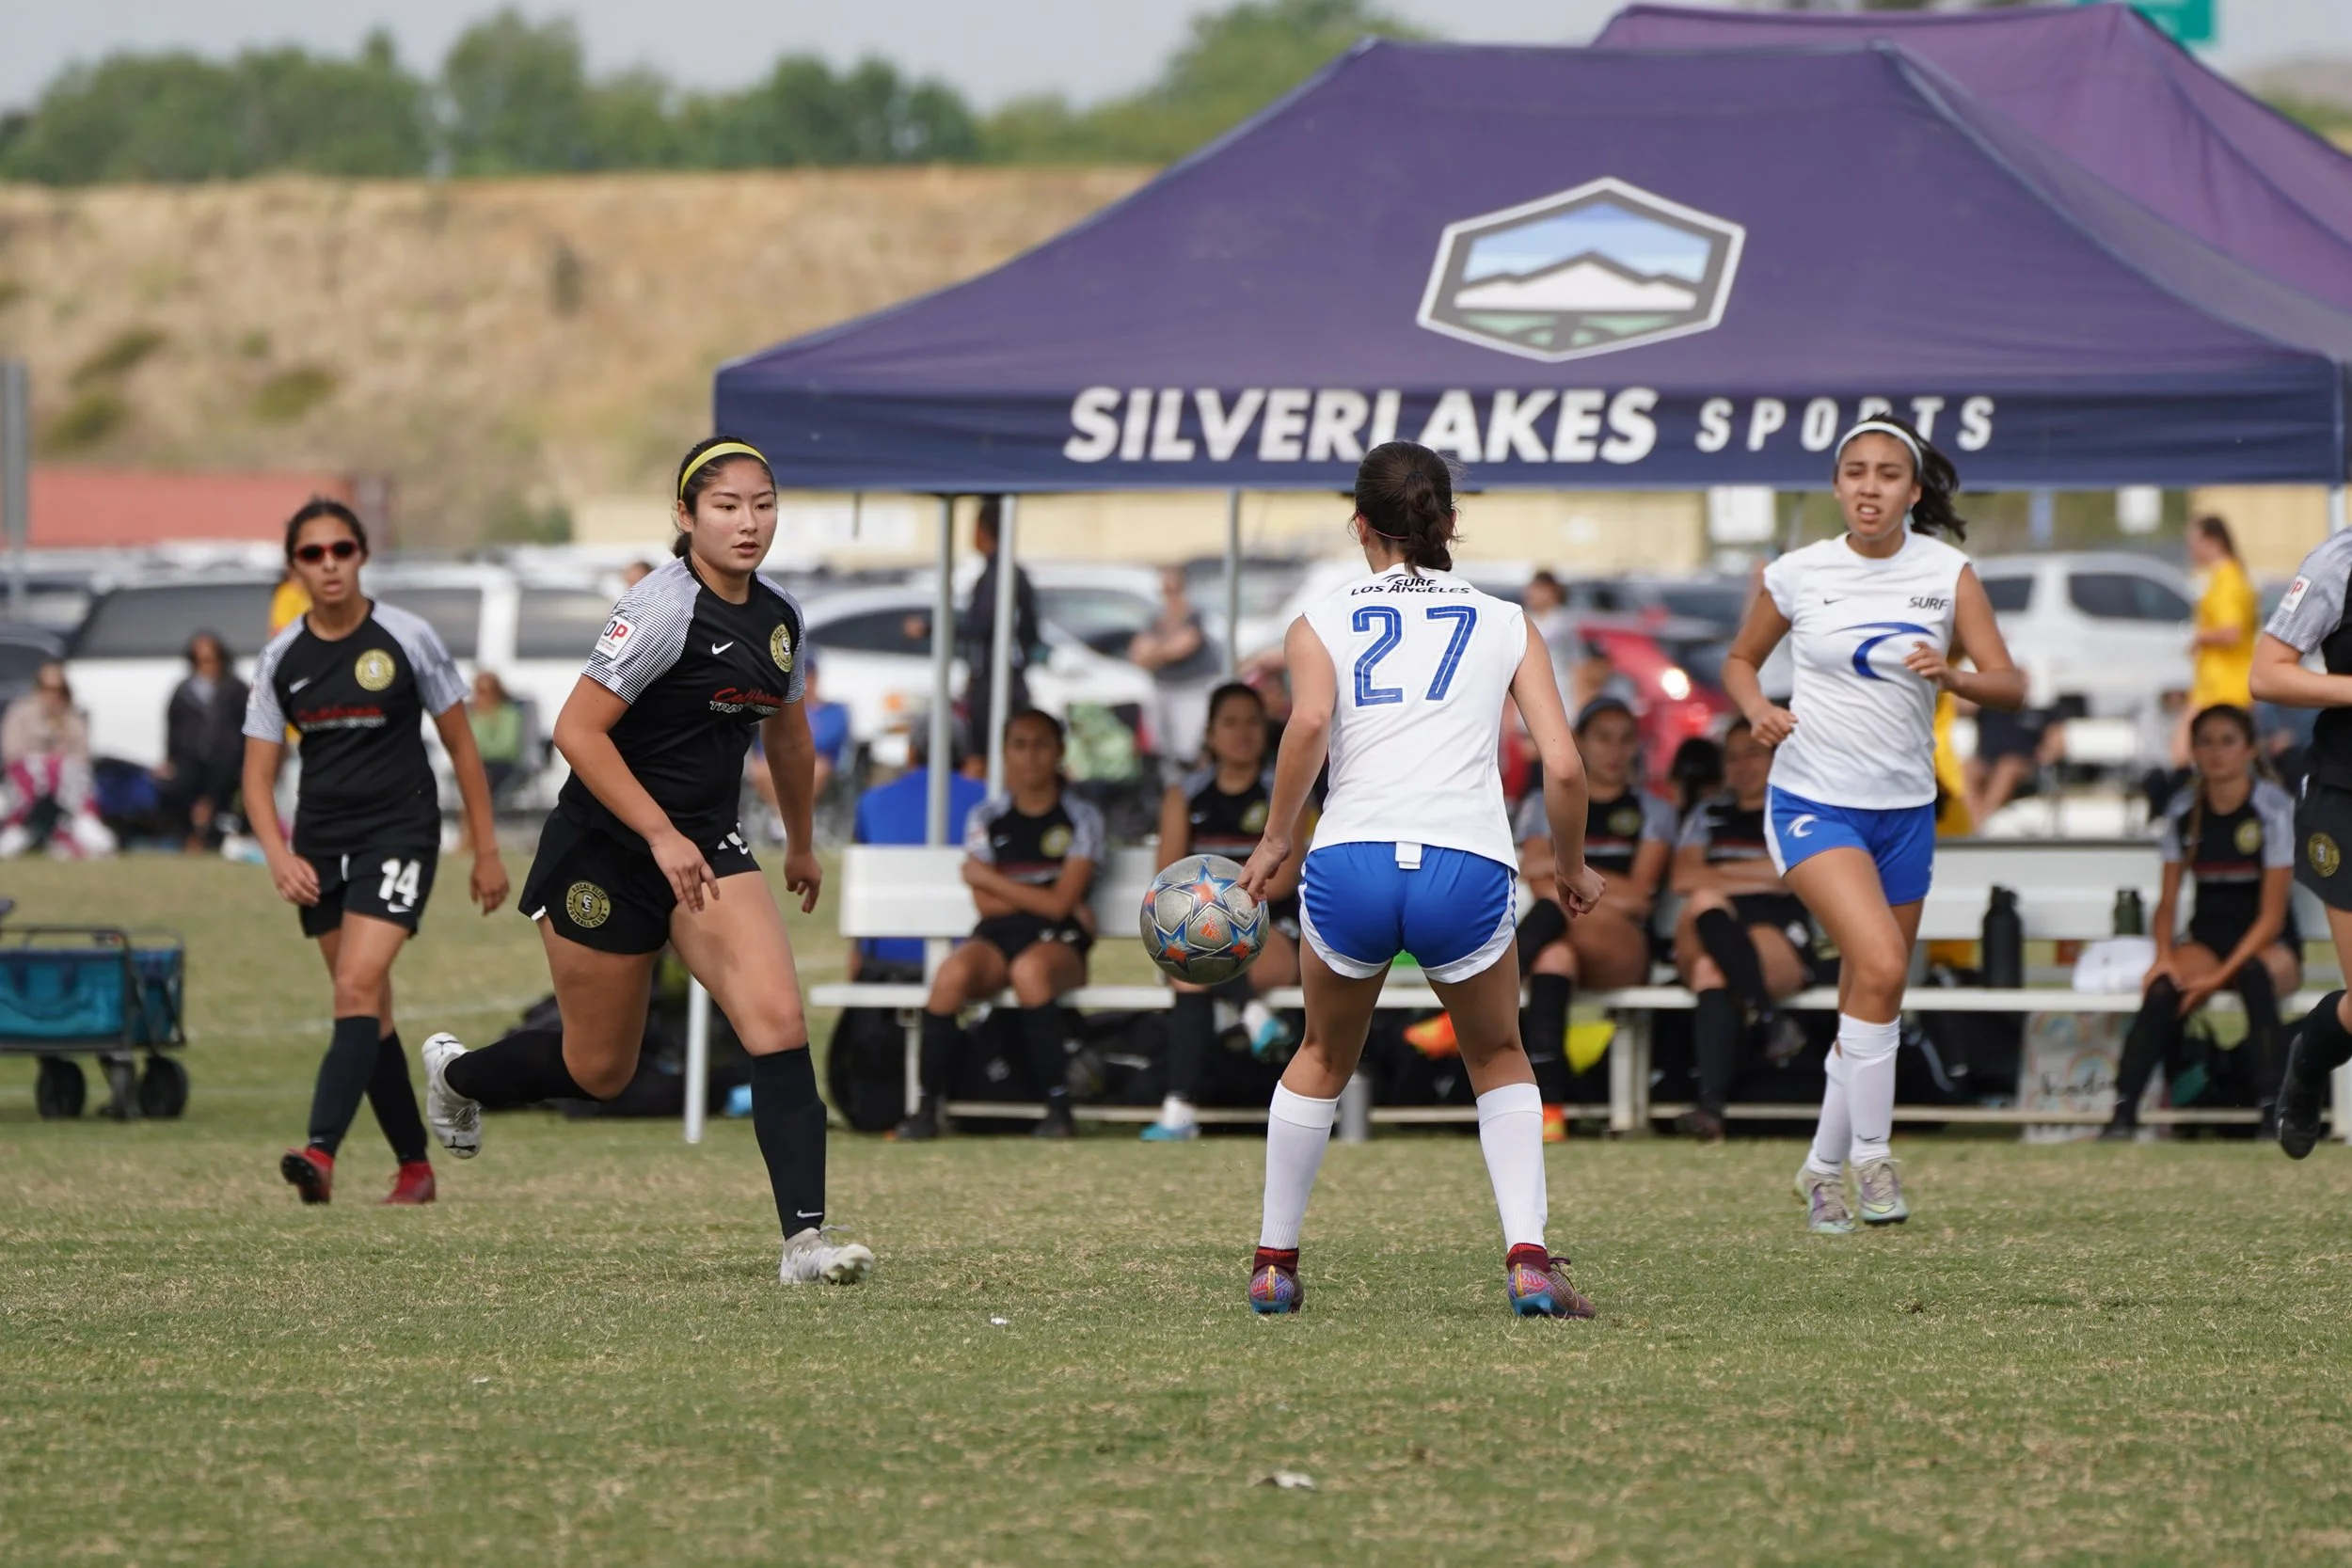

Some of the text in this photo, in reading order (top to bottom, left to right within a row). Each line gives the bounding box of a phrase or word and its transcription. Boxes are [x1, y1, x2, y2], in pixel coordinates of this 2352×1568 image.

[1394, 578, 1438, 587] SURF
[1351, 584, 1471, 596] LOS ANGELES
[1908, 596, 1951, 610] SURF
[1352, 605, 1477, 707] 27
[378, 858, 421, 908] 14
